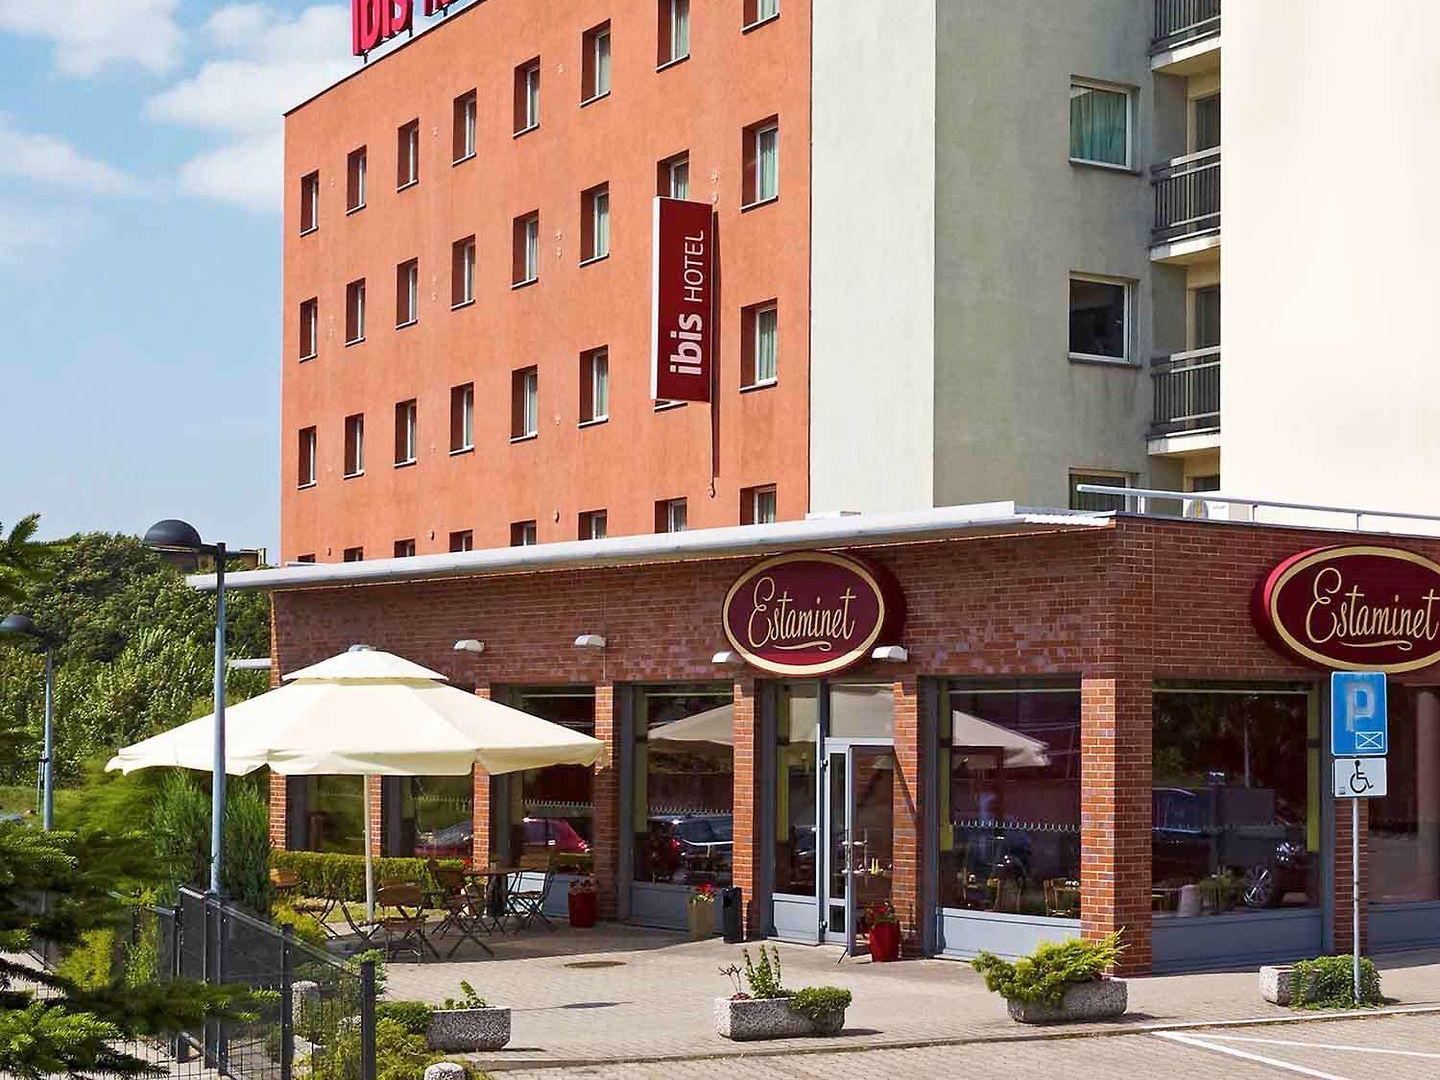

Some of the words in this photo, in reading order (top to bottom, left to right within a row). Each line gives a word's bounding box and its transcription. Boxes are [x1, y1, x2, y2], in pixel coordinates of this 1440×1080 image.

[684, 230, 704, 302] HOTEL
[670, 313, 702, 375] ibis
[748, 577, 858, 648] Estaminet
[1305, 567, 1440, 643] Estaminet
[1346, 683, 1377, 732] P
